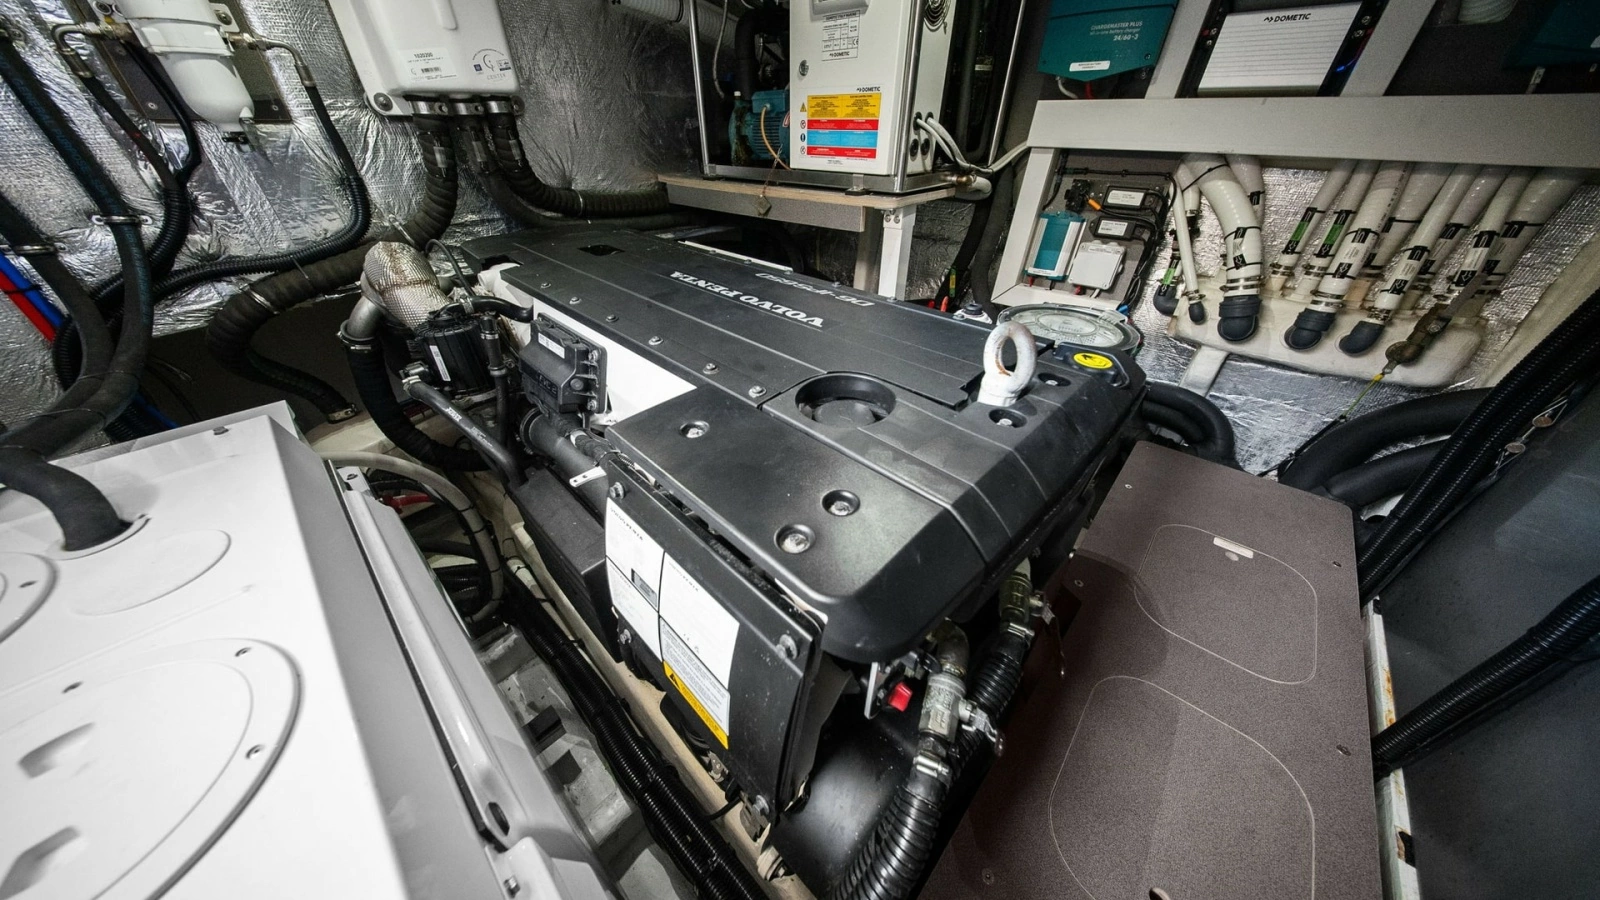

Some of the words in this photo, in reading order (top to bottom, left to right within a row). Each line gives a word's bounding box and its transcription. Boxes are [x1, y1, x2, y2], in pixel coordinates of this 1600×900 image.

[1090, 22, 1129, 31] CHARGEMASTER
[1129, 20, 1143, 28] PLUS
[1274, 13, 1312, 23] DOMETIC
[669, 271, 743, 298] PENTA
[739, 295, 826, 328] VOLVO
